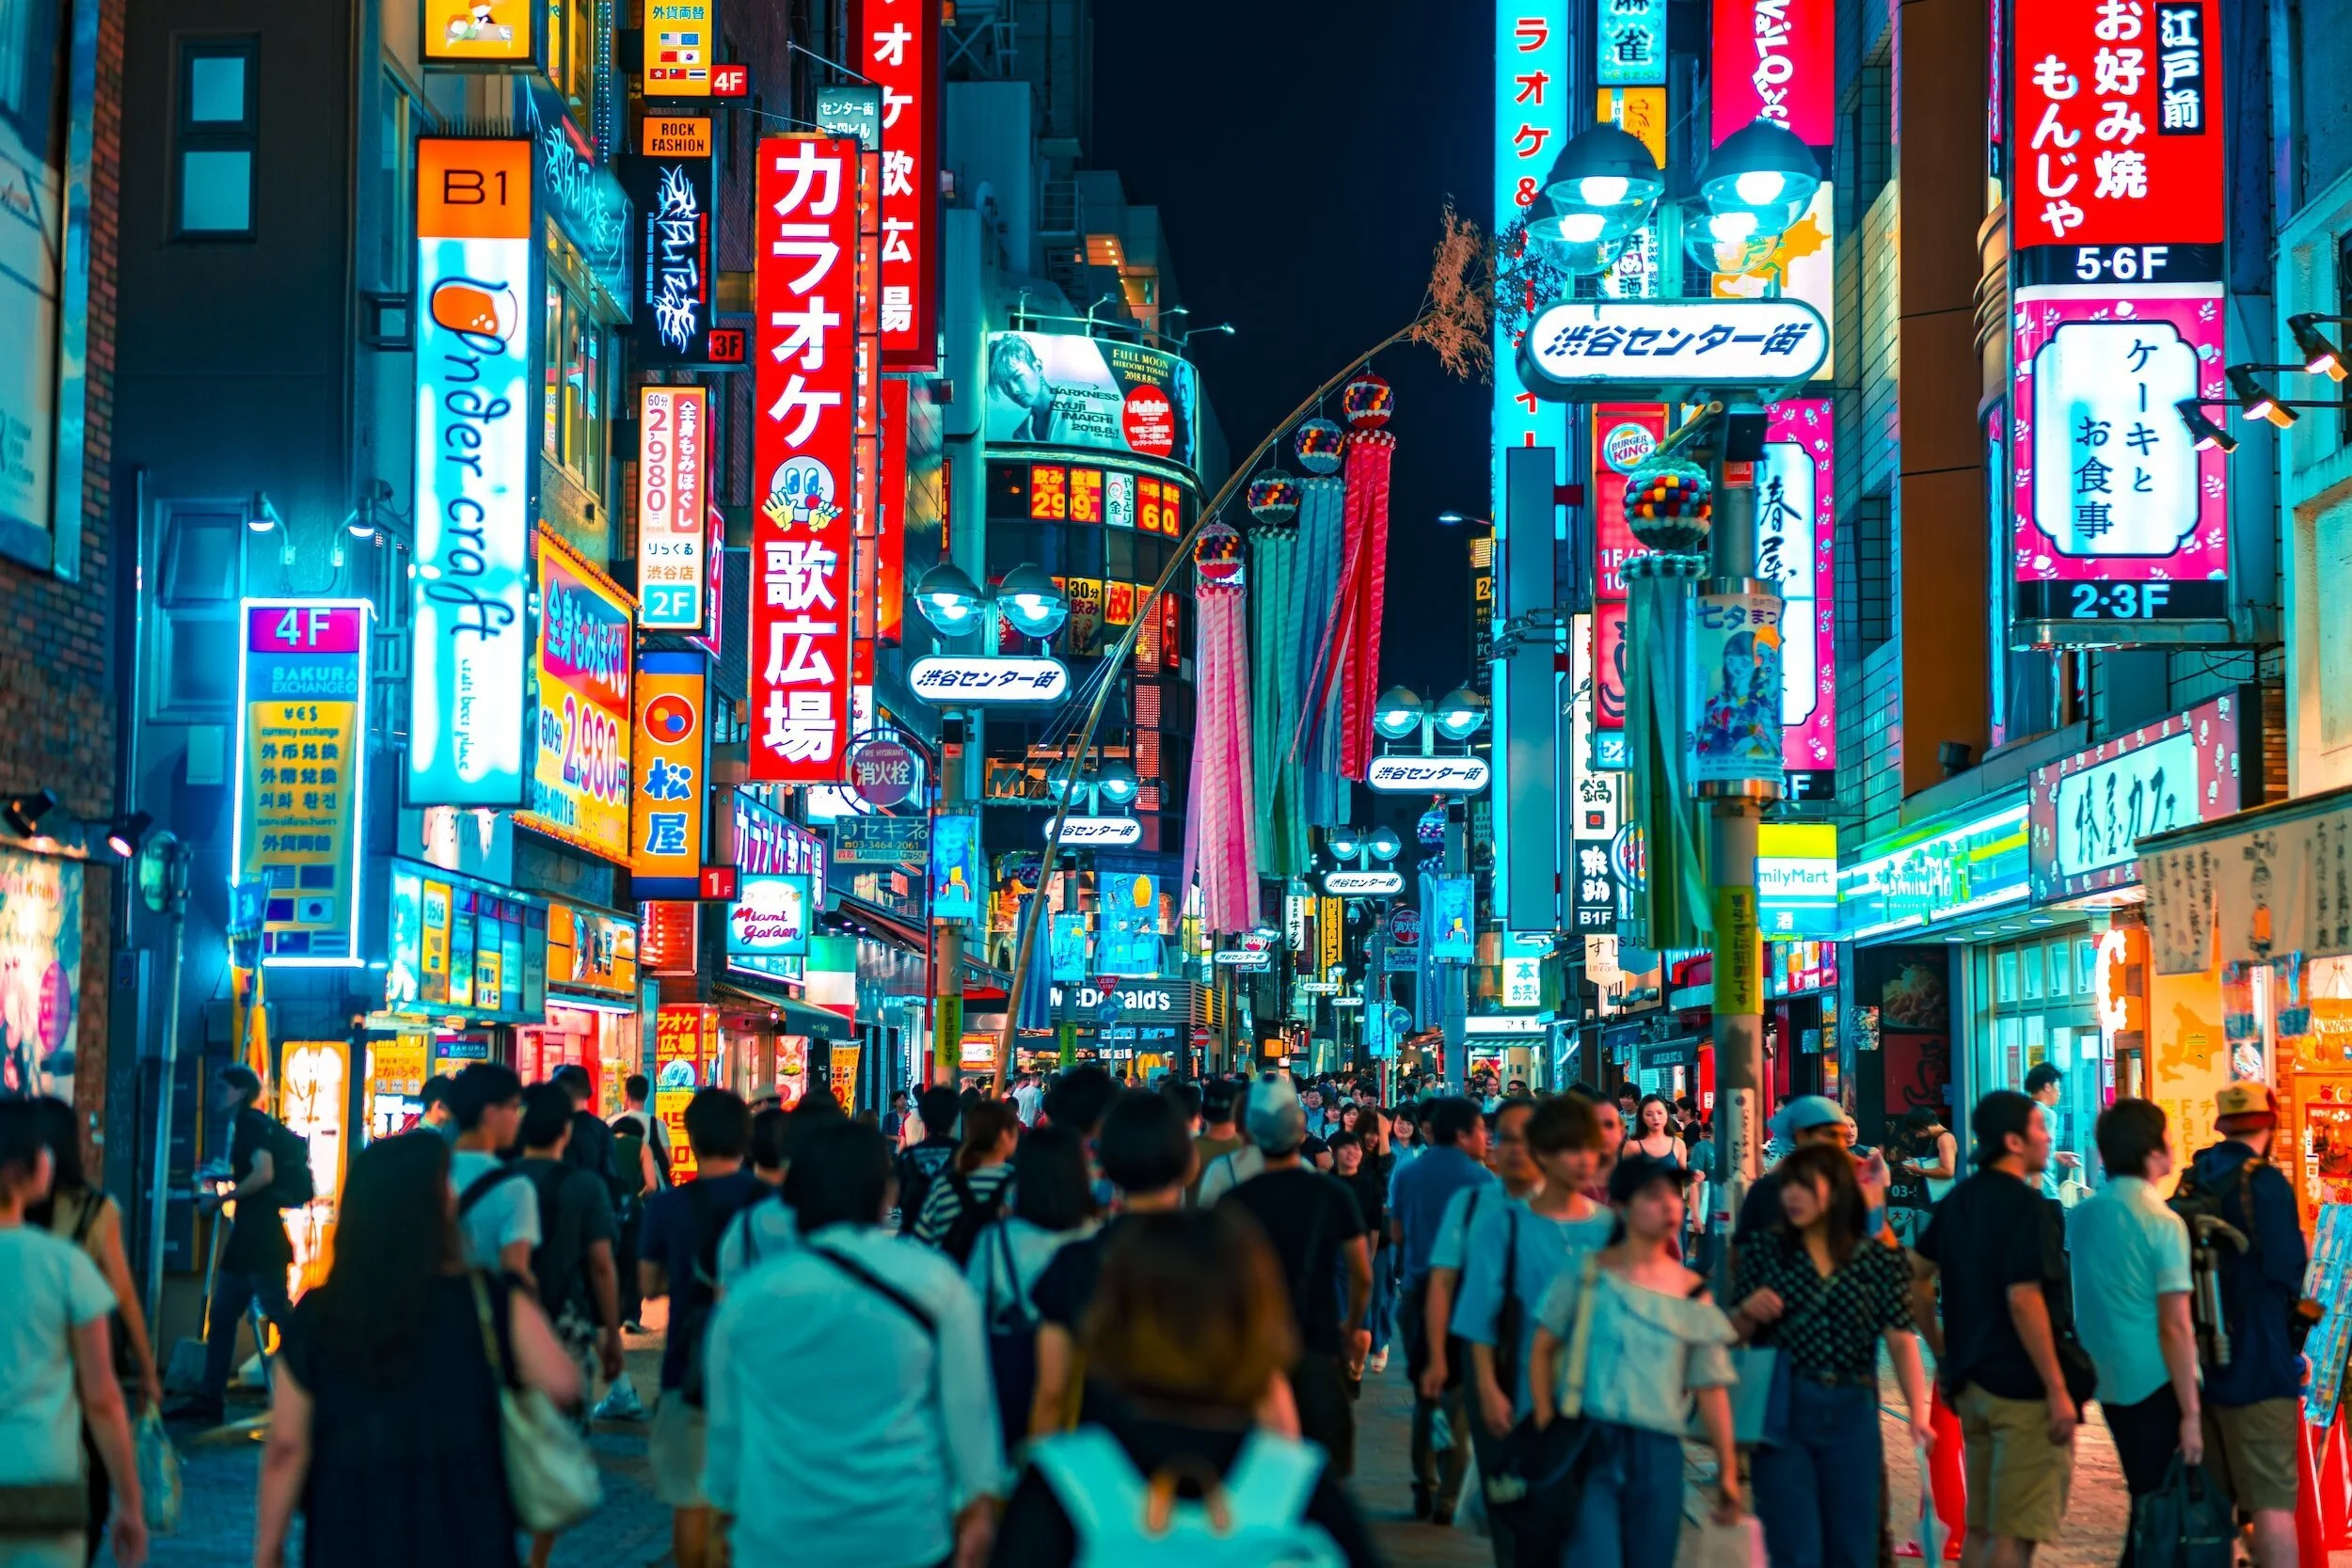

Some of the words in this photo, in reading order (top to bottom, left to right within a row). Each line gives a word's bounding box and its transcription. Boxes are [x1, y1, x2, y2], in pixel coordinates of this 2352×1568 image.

[653, 6, 705, 20] 外貨両替
[2162, 9, 2201, 130] 江戸前
[713, 71, 743, 91] 4F
[821, 102, 874, 116] センター街
[661, 123, 695, 136] ROCK
[652, 139, 705, 151] FASHION
[2031, 54, 2084, 238] もんじゃ
[444, 170, 507, 206] B1
[714, 335, 739, 357] 3F
[1544, 324, 1814, 357] 渋谷センター街
[1113, 348, 1139, 362] FULL
[1142, 355, 1168, 369] MOON
[1113, 360, 1145, 372] HIROOMI
[647, 395, 669, 407] 60分
[1050, 387, 1120, 402] DARKNESS
[2125, 339, 2161, 494] ケーキと
[1072, 423, 1120, 436] 2018.8.1
[1612, 435, 1648, 452] BURGER
[1613, 443, 1649, 464] KING
[677, 400, 697, 527] 全身もみほぐし
[2073, 417, 2114, 541] お食事
[1123, 477, 1133, 524] やきとり
[647, 543, 694, 556] りらくる
[424, 497, 515, 641] craft
[646, 564, 694, 580] 渋谷店
[1070, 580, 1099, 598] 30分
[651, 592, 691, 616] 2F
[1071, 598, 1099, 615] 飲み
[274, 609, 330, 646] 4F
[547, 577, 628, 698] 全身もみほぐし
[272, 666, 357, 681] SAKURA
[916, 669, 1059, 689] 渋谷センター街
[272, 681, 345, 693] EXCHANGE
[541, 706, 563, 754] 60分
[856, 760, 911, 785] 消火栓
[1374, 766, 1485, 782] 渋谷センター街
[1580, 779, 1613, 804] 鍋
[644, 757, 693, 856] 松屋
[861, 818, 928, 840] セキネ
[1049, 824, 1136, 837] 谷センター街
[707, 872, 731, 896] 1F
[1329, 878, 1399, 888] 渋谷センター街
[730, 907, 787, 922] Miami
[1580, 911, 1613, 926] B1F
[1290, 920, 1302, 950] 牛タン
[1588, 937, 1619, 958] すし
[1516, 961, 1534, 980] 本
